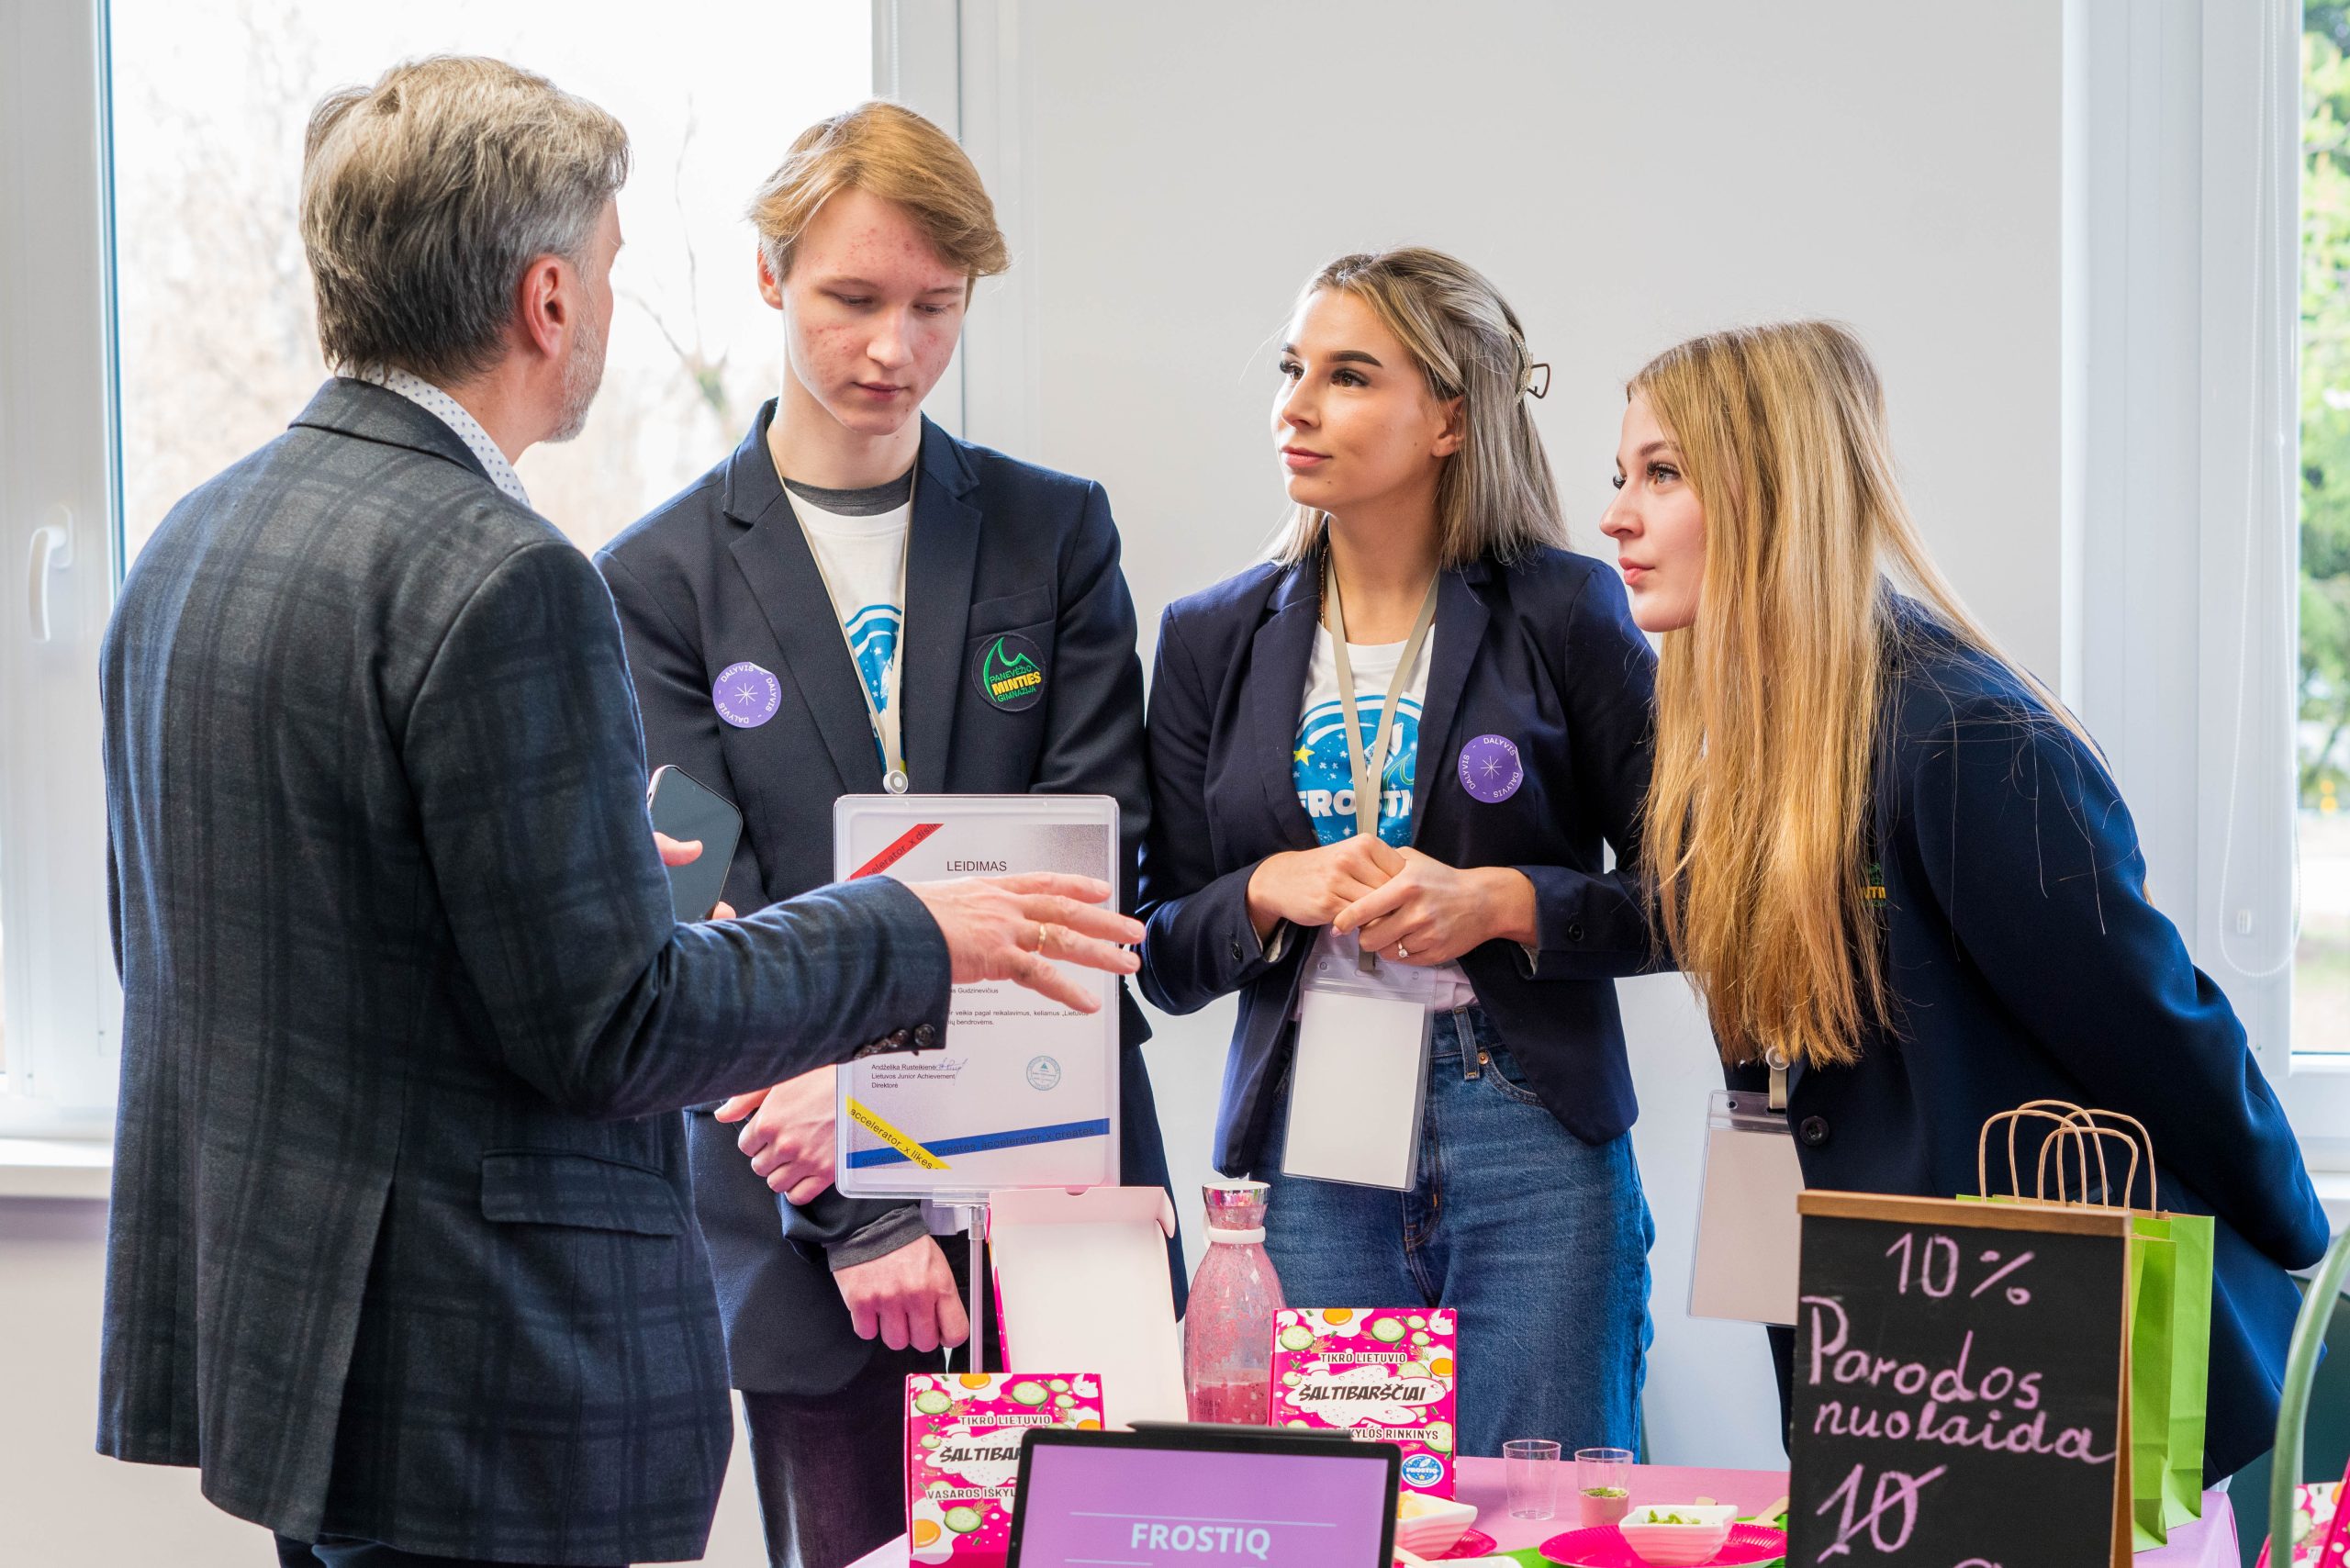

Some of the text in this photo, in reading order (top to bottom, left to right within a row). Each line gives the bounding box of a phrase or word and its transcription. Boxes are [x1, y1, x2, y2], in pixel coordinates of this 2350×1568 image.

[720, 665, 755, 683] DALYVIS
[990, 665, 1032, 683] PANEVĖŽIO
[991, 671, 1042, 696] MINTIES
[765, 677, 778, 712] DALYVIS
[997, 686, 1036, 702] GIMNAZIJA
[719, 702, 750, 724] DALYVIS
[1483, 737, 1516, 756] DALYVIS
[1461, 754, 1476, 790] DALYVIS
[1493, 771, 1519, 798] DALYVIS
[946, 860, 1007, 872] LEIDIMAS
[911, 1148, 934, 1170] likes
[1321, 1353, 1406, 1363] TIKRO LIETUVIO
[1799, 1295, 2043, 1411] Parodos
[1299, 1383, 1427, 1401] ŠALTIBARŠČIAI
[959, 1416, 1051, 1425] TIKRO LIETUVIO
[1385, 1429, 1438, 1439] RINKINYS
[1814, 1399, 2118, 1464] nuolaida
[939, 1446, 1021, 1462] ŠALTIBAR
[927, 1486, 1015, 1499] VASAROS IŠKYL
[1131, 1523, 1271, 1560] FROSTIQ
